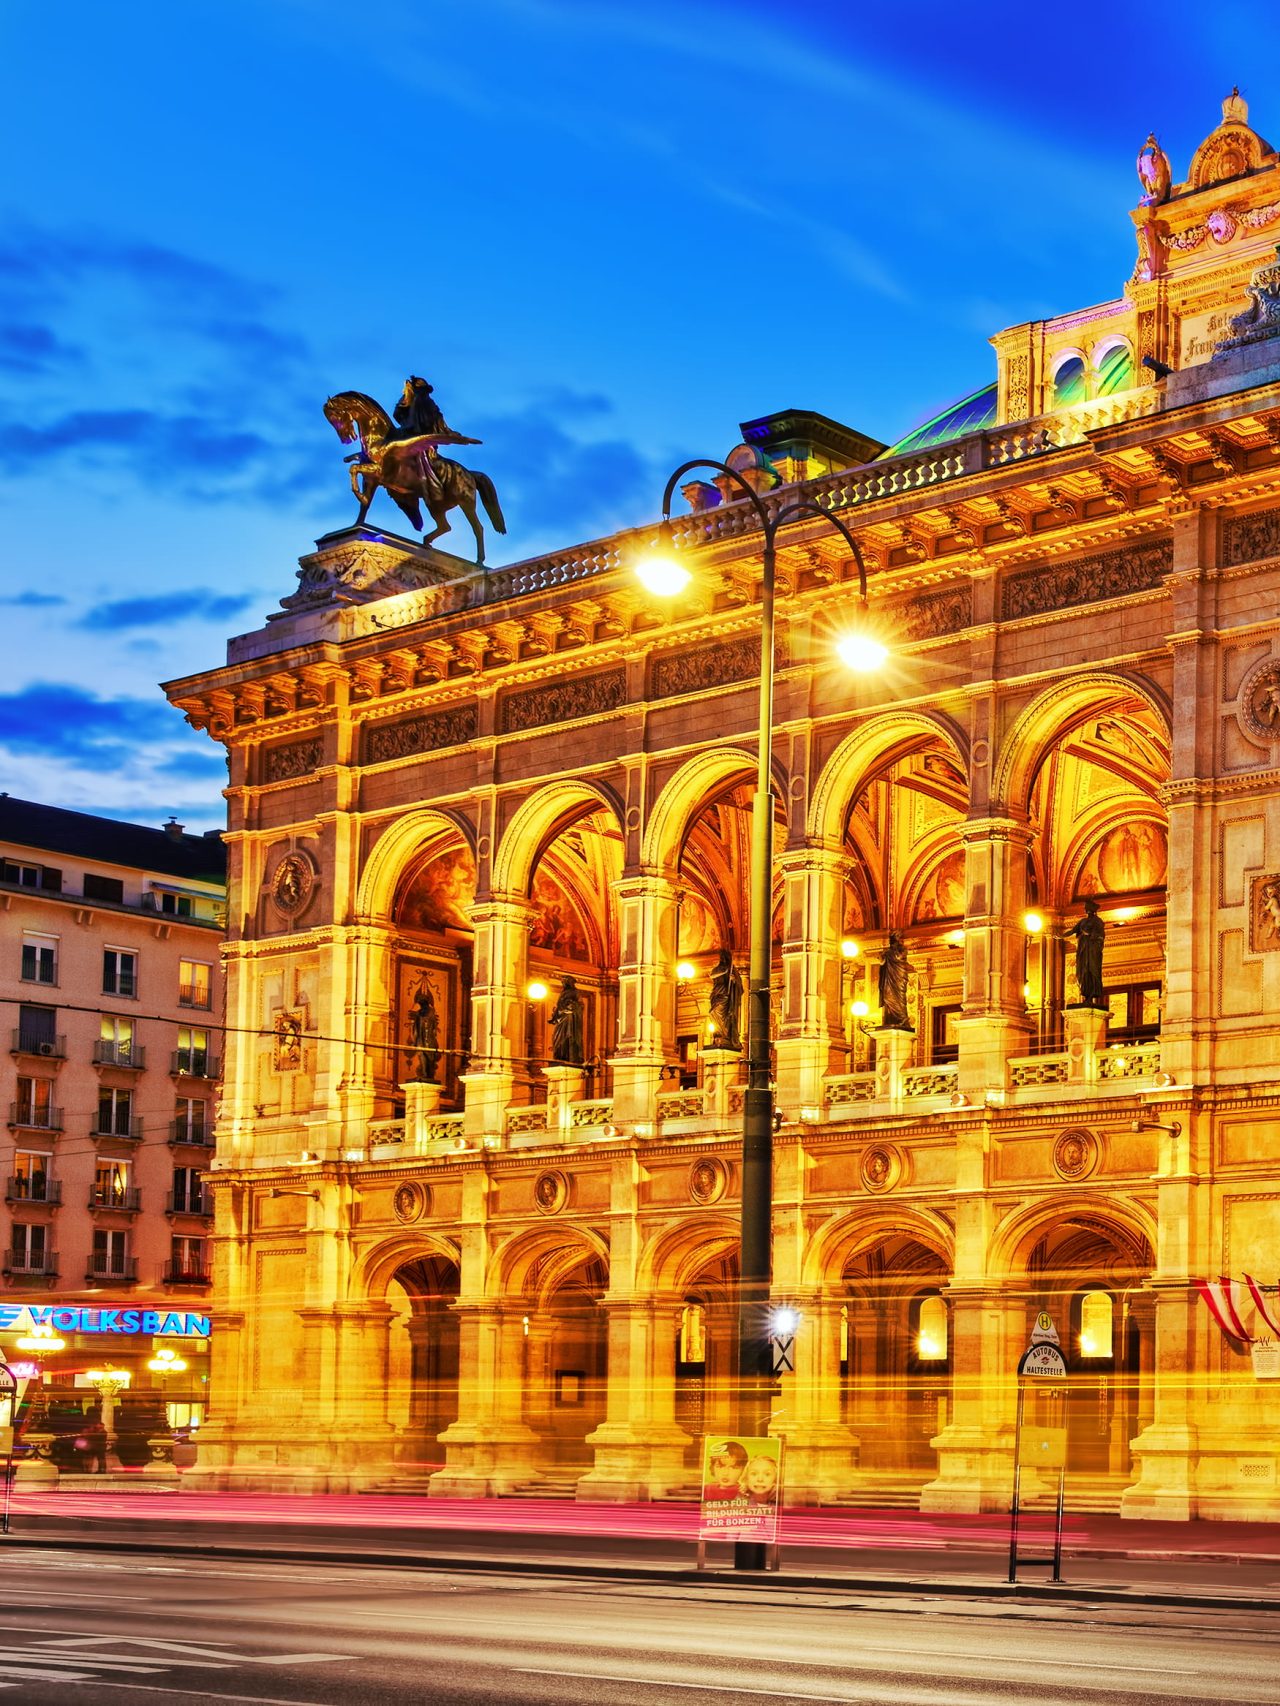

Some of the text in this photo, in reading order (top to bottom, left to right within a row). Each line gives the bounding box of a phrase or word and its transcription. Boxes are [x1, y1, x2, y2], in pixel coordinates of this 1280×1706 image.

[1041, 1315, 1049, 1328] H
[1032, 1347, 1060, 1361] AUTOBUS
[1026, 1366, 1063, 1376] HALTESTELLE
[706, 1498, 748, 1508] GELD FÜR
[706, 1507, 772, 1518] BILDUNG STATT
[706, 1517, 765, 1526] FÜR BONZEN.
